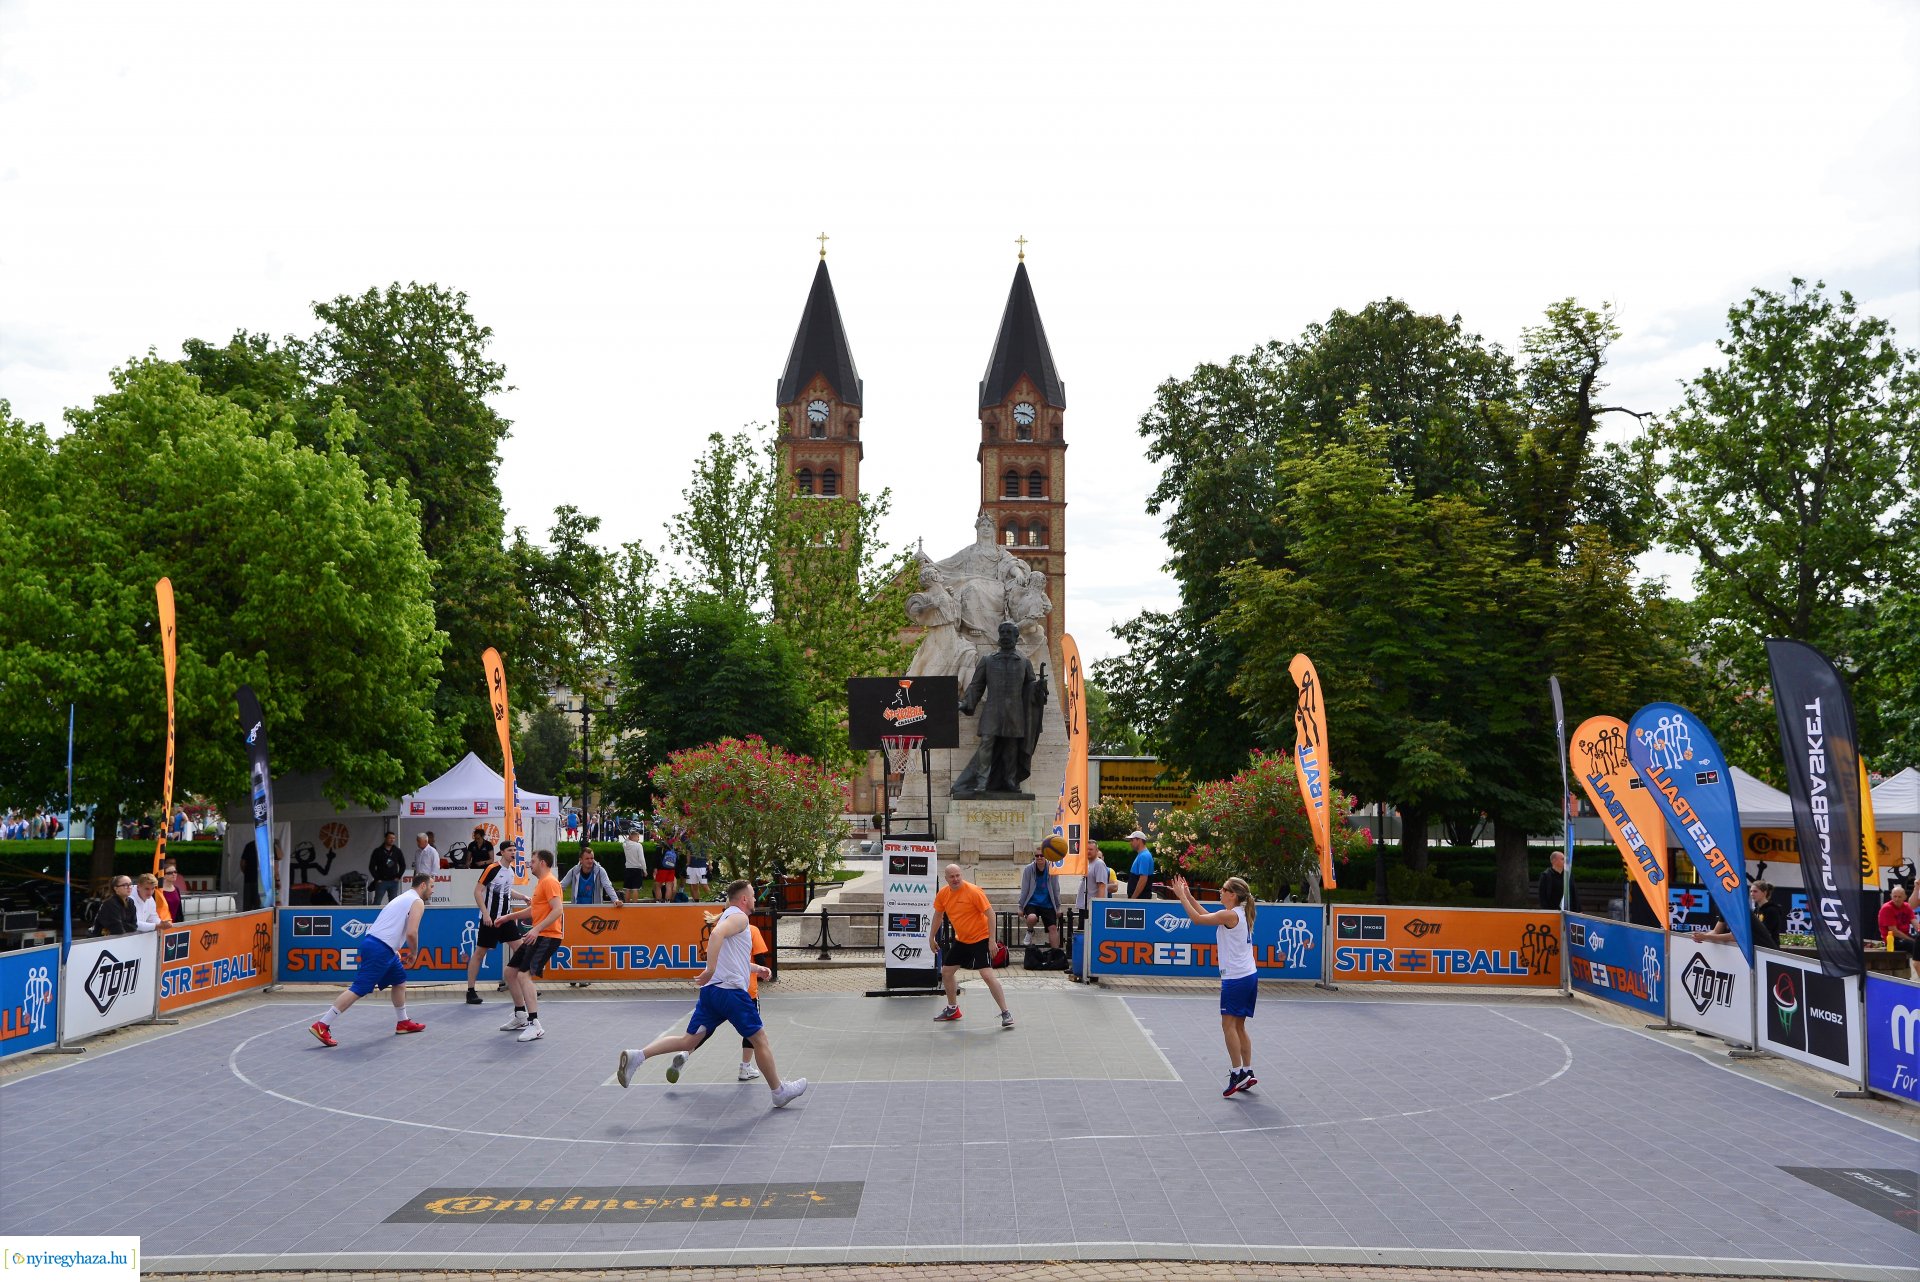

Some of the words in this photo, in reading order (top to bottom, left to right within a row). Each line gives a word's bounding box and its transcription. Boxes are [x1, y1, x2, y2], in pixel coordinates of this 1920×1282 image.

[967, 811, 1025, 822] KOSSUTH
[889, 883, 928, 894] MVM
[1412, 921, 1442, 935] TOTI
[98, 957, 142, 1001] TOTI
[1692, 966, 1736, 1008] TOTI
[1810, 1006, 1844, 1025] MKOSZ
